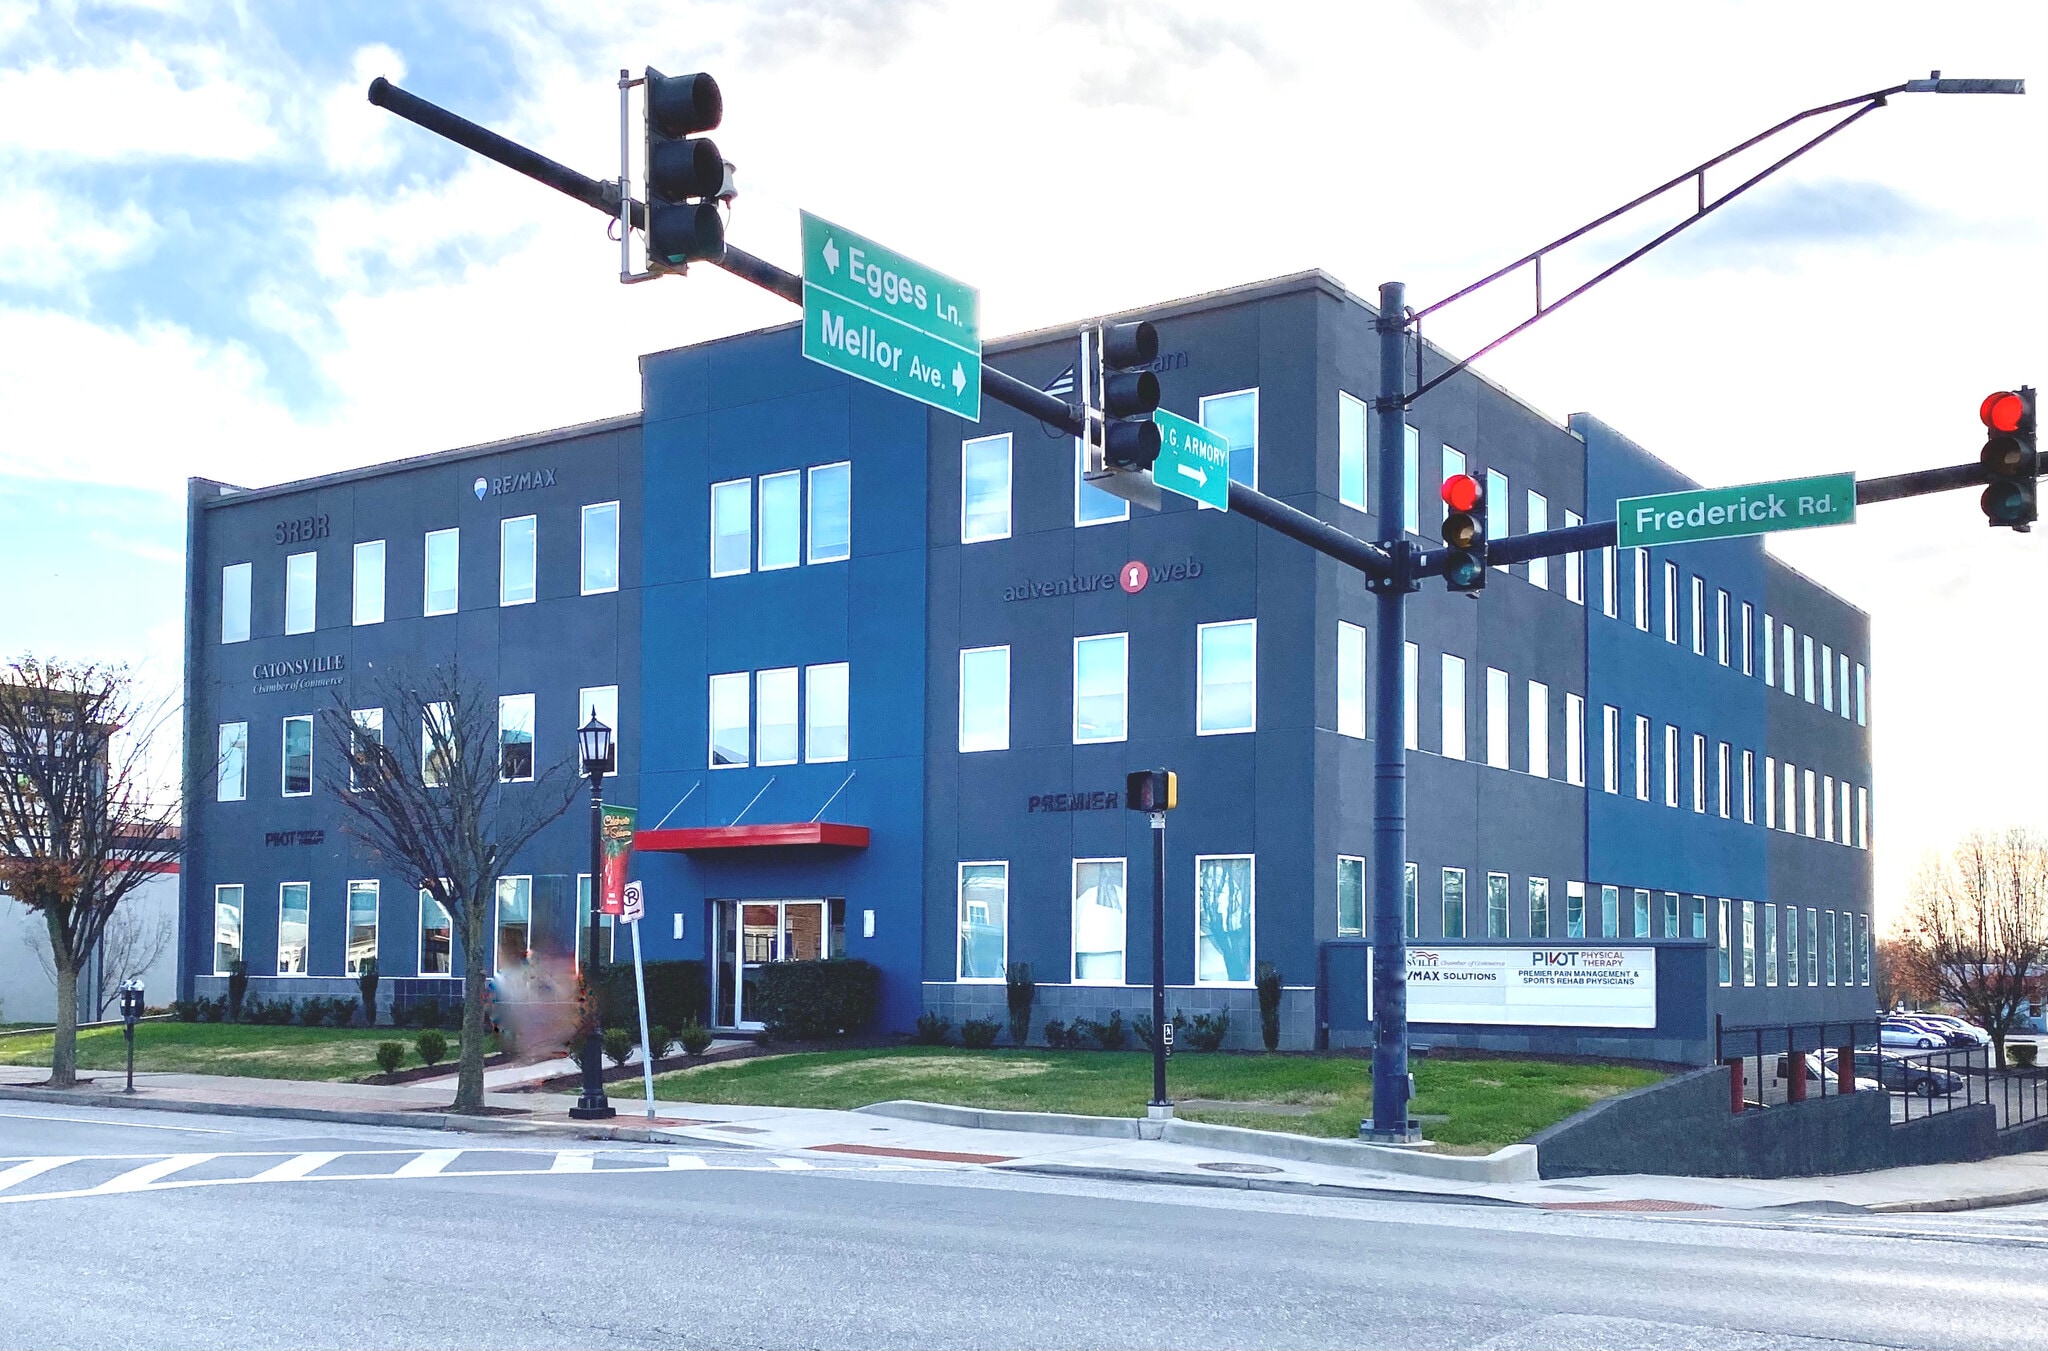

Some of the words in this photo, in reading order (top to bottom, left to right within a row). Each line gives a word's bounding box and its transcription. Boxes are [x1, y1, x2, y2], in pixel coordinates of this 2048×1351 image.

[849, 246, 927, 310] Egges
[936, 294, 963, 326] Ln.
[821, 310, 903, 372] Mellor
[909, 356, 946, 389] Ave.
[1184, 434, 1226, 468] ARMORY
[493, 467, 557, 496] RE/MAX
[1636, 493, 1787, 533] Frederick
[1799, 494, 1838, 516] Rd.
[275, 513, 330, 546] SRBR
[1002, 573, 1116, 602] adventure
[1151, 556, 1203, 583] web
[253, 655, 344, 680] CATONSVILLE
[253, 681, 290, 695] Chamber
[290, 679, 300, 692] of
[300, 676, 344, 689] Commerce
[1028, 791, 1118, 813] PREMIER
[1532, 952, 1579, 966] PIVOT
[1406, 971, 1440, 981] /MAX
[1443, 972, 1497, 981] SOLUTIONS
[1556, 977, 1585, 985] REHAB
[1586, 977, 1635, 985] PHYSICIANS
